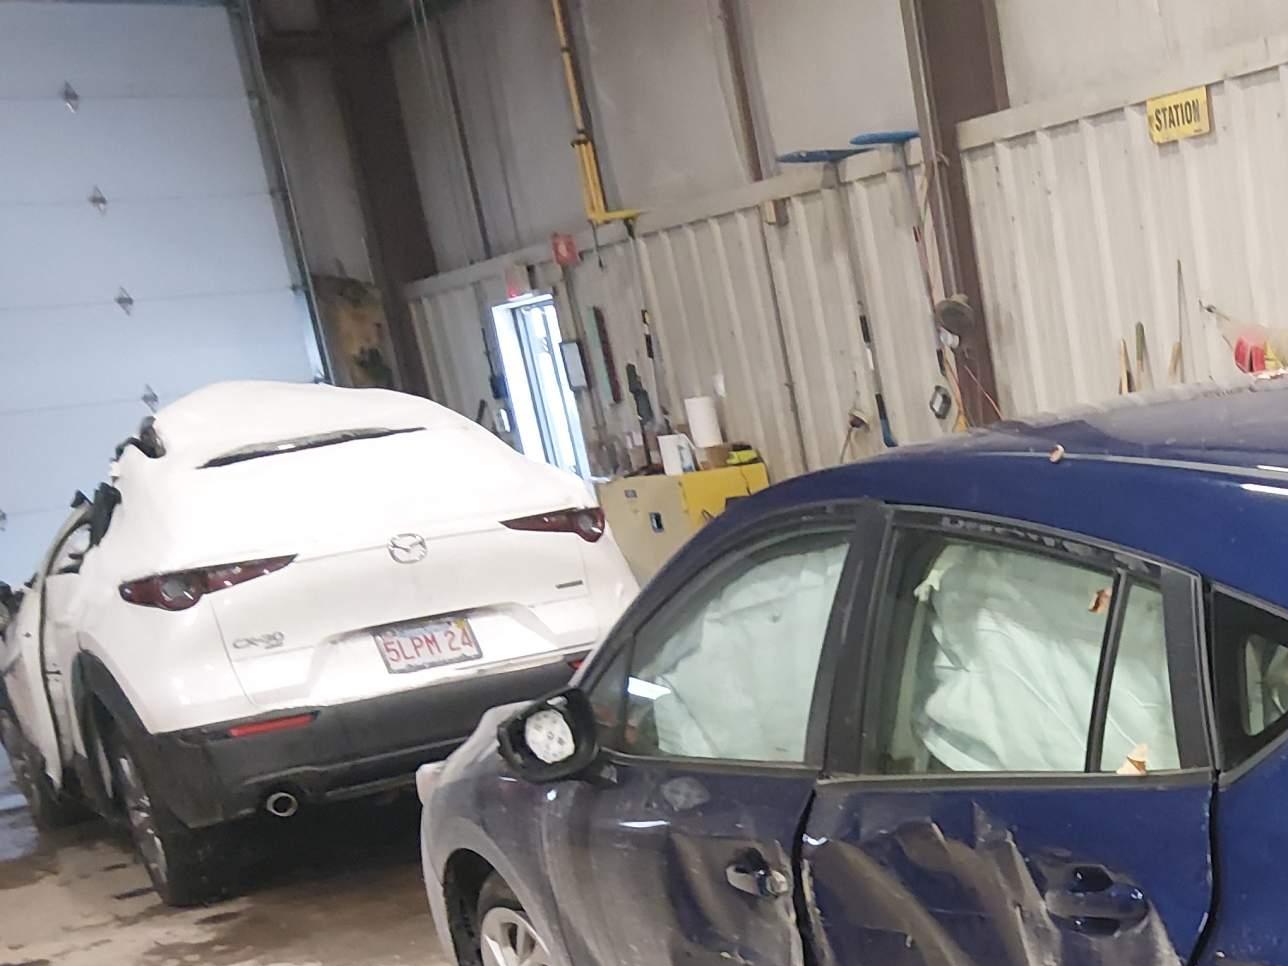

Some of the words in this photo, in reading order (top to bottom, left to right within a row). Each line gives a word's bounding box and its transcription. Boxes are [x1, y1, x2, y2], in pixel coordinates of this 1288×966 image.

[1154, 99, 1200, 132] STATION
[383, 632, 442, 663] 5LPM
[444, 626, 473, 652] 24
